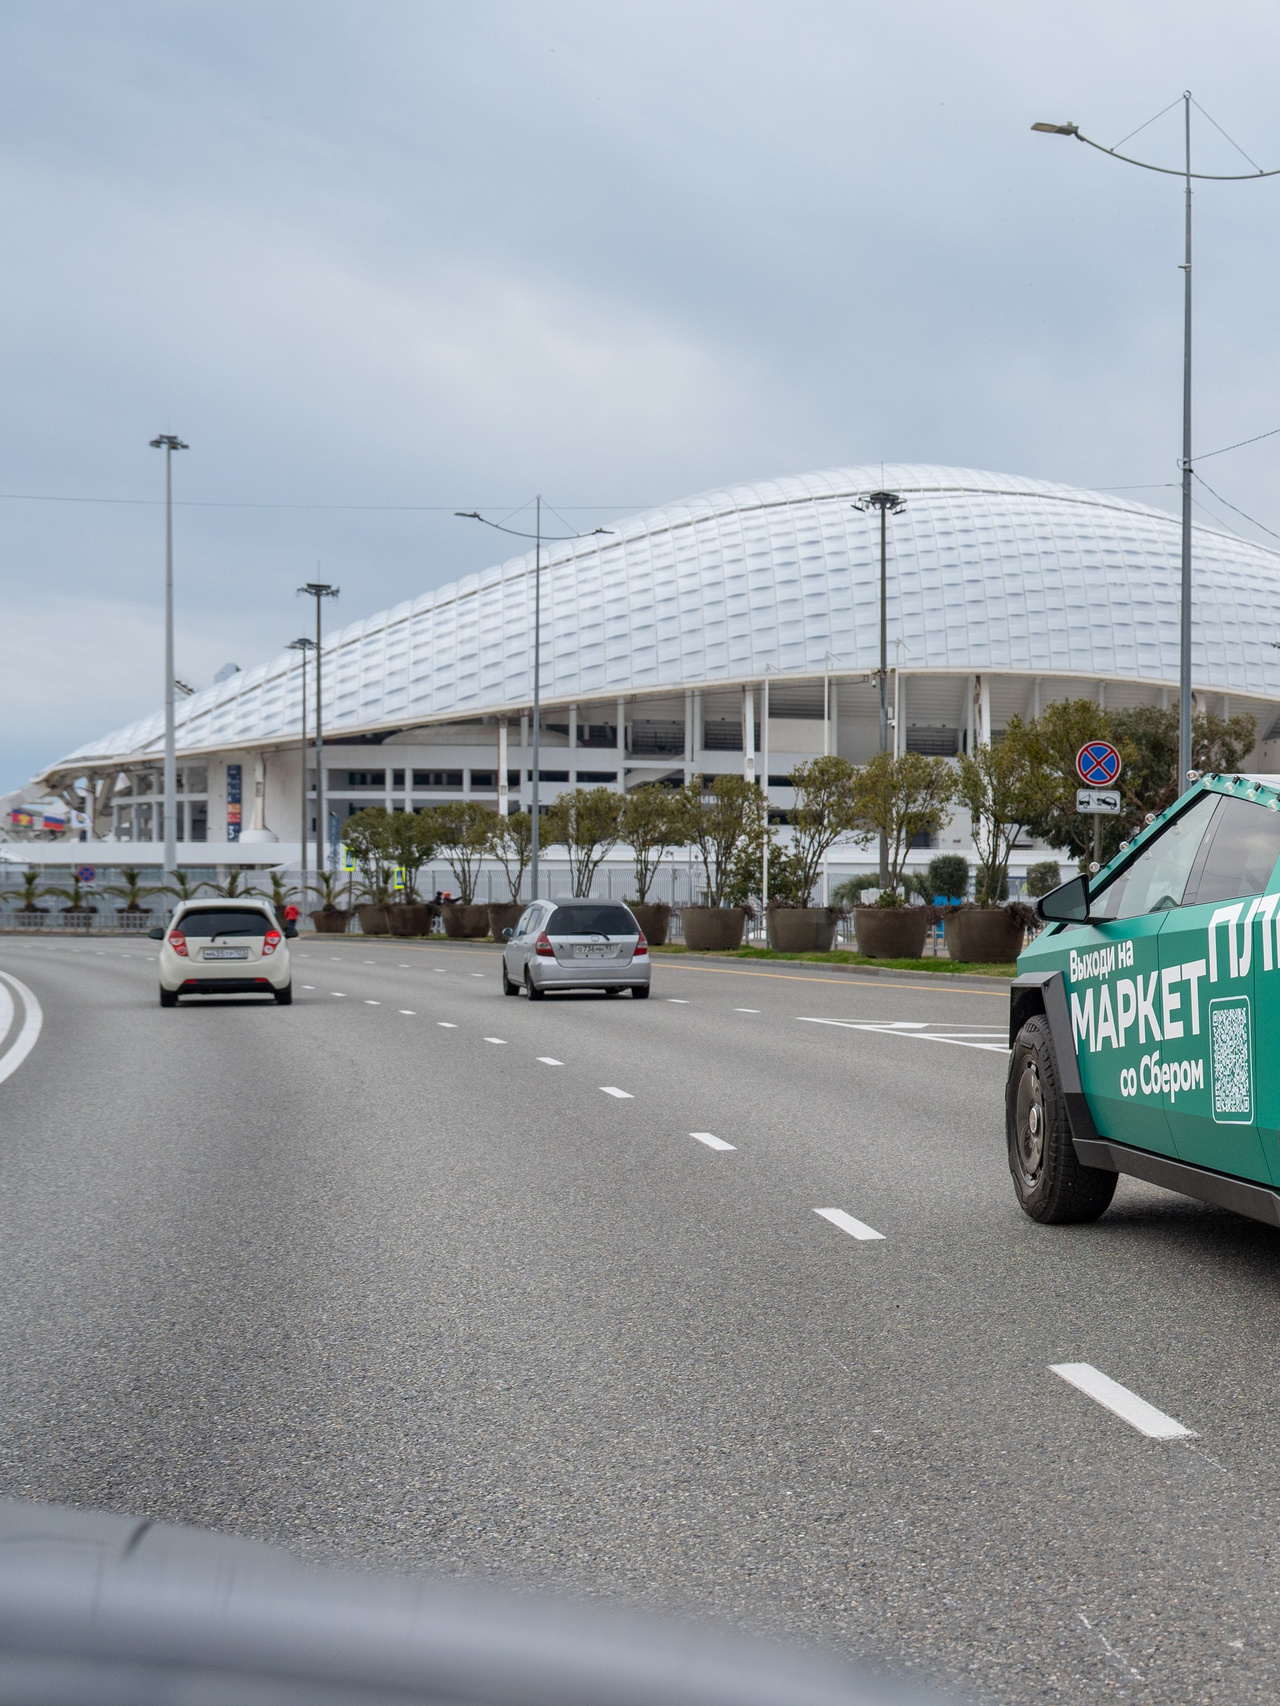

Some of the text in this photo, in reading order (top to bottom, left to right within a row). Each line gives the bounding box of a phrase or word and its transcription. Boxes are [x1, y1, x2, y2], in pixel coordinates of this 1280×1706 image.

[1069, 939, 1135, 983] Выходи на
[1070, 958, 1206, 1055] МАРКЕТ
[1120, 1049, 1205, 1103] со Сбером
